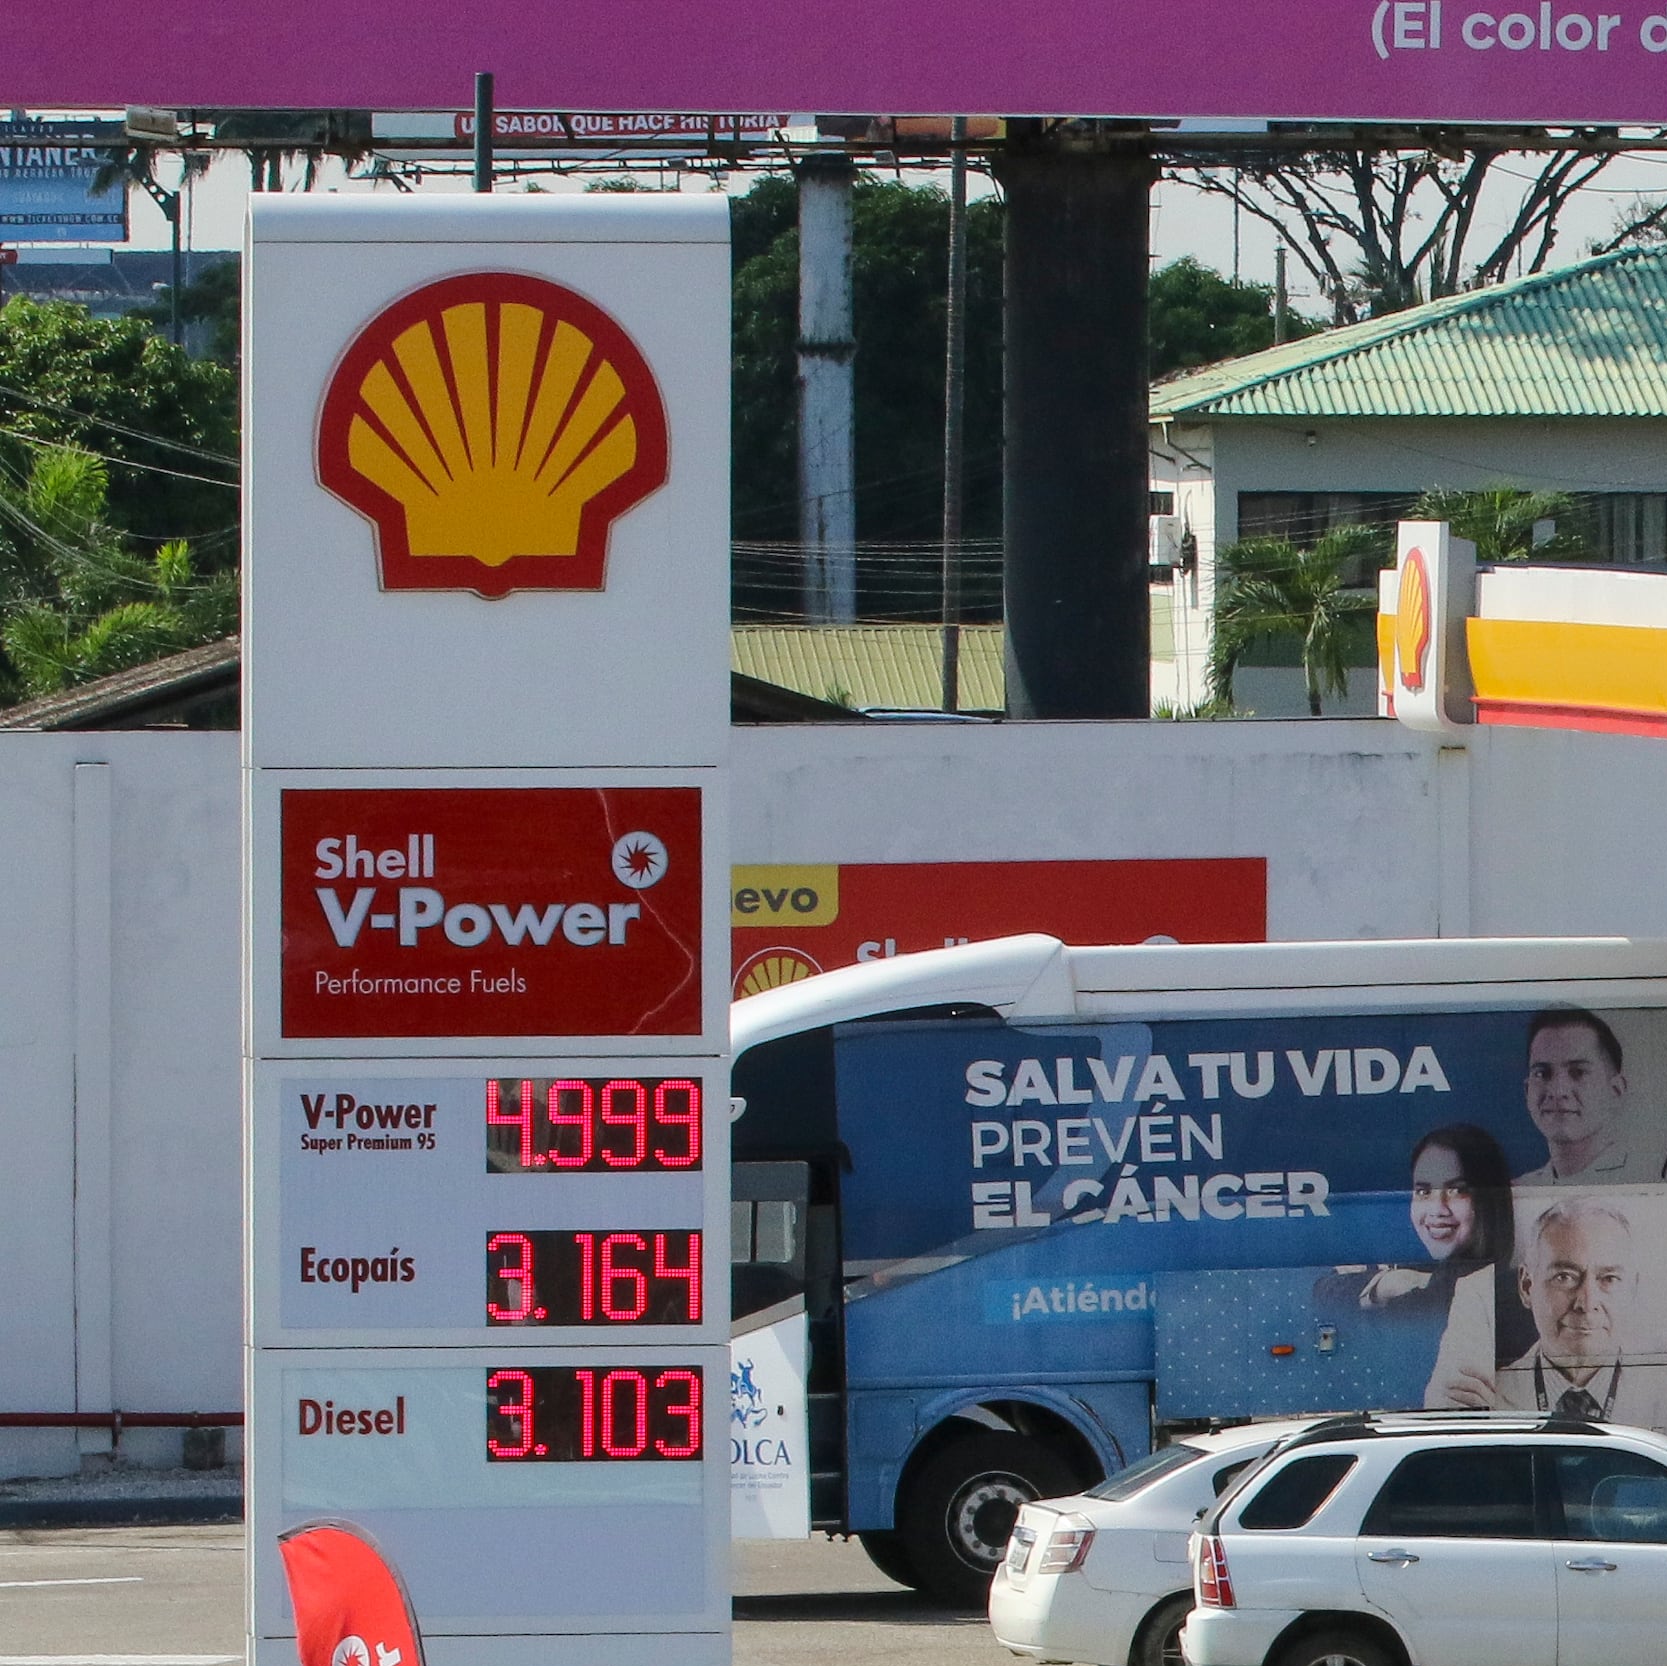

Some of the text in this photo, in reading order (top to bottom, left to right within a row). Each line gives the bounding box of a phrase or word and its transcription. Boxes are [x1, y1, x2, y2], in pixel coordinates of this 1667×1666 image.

[1371, 0, 1441, 59] (El
[1463, 0, 1620, 52] color
[315, 834, 434, 879] Shell
[315, 887, 641, 948] V-Power
[732, 887, 818, 914] evo
[316, 969, 527, 995] Performance Fuels
[965, 1046, 1450, 1107] SALVA TU VIDA
[301, 1094, 436, 1129] V-Power
[486, 1079, 699, 1167] 4.999
[972, 1101, 1224, 1168] PREVÉN
[301, 1134, 436, 1154] Super Premium 95
[973, 1160, 1331, 1230] EL CÁNCER
[300, 1247, 415, 1293] Ecopaís
[486, 1233, 699, 1320] 3.164
[299, 1396, 405, 1435] Diesel
[486, 1370, 699, 1457] 3.103
